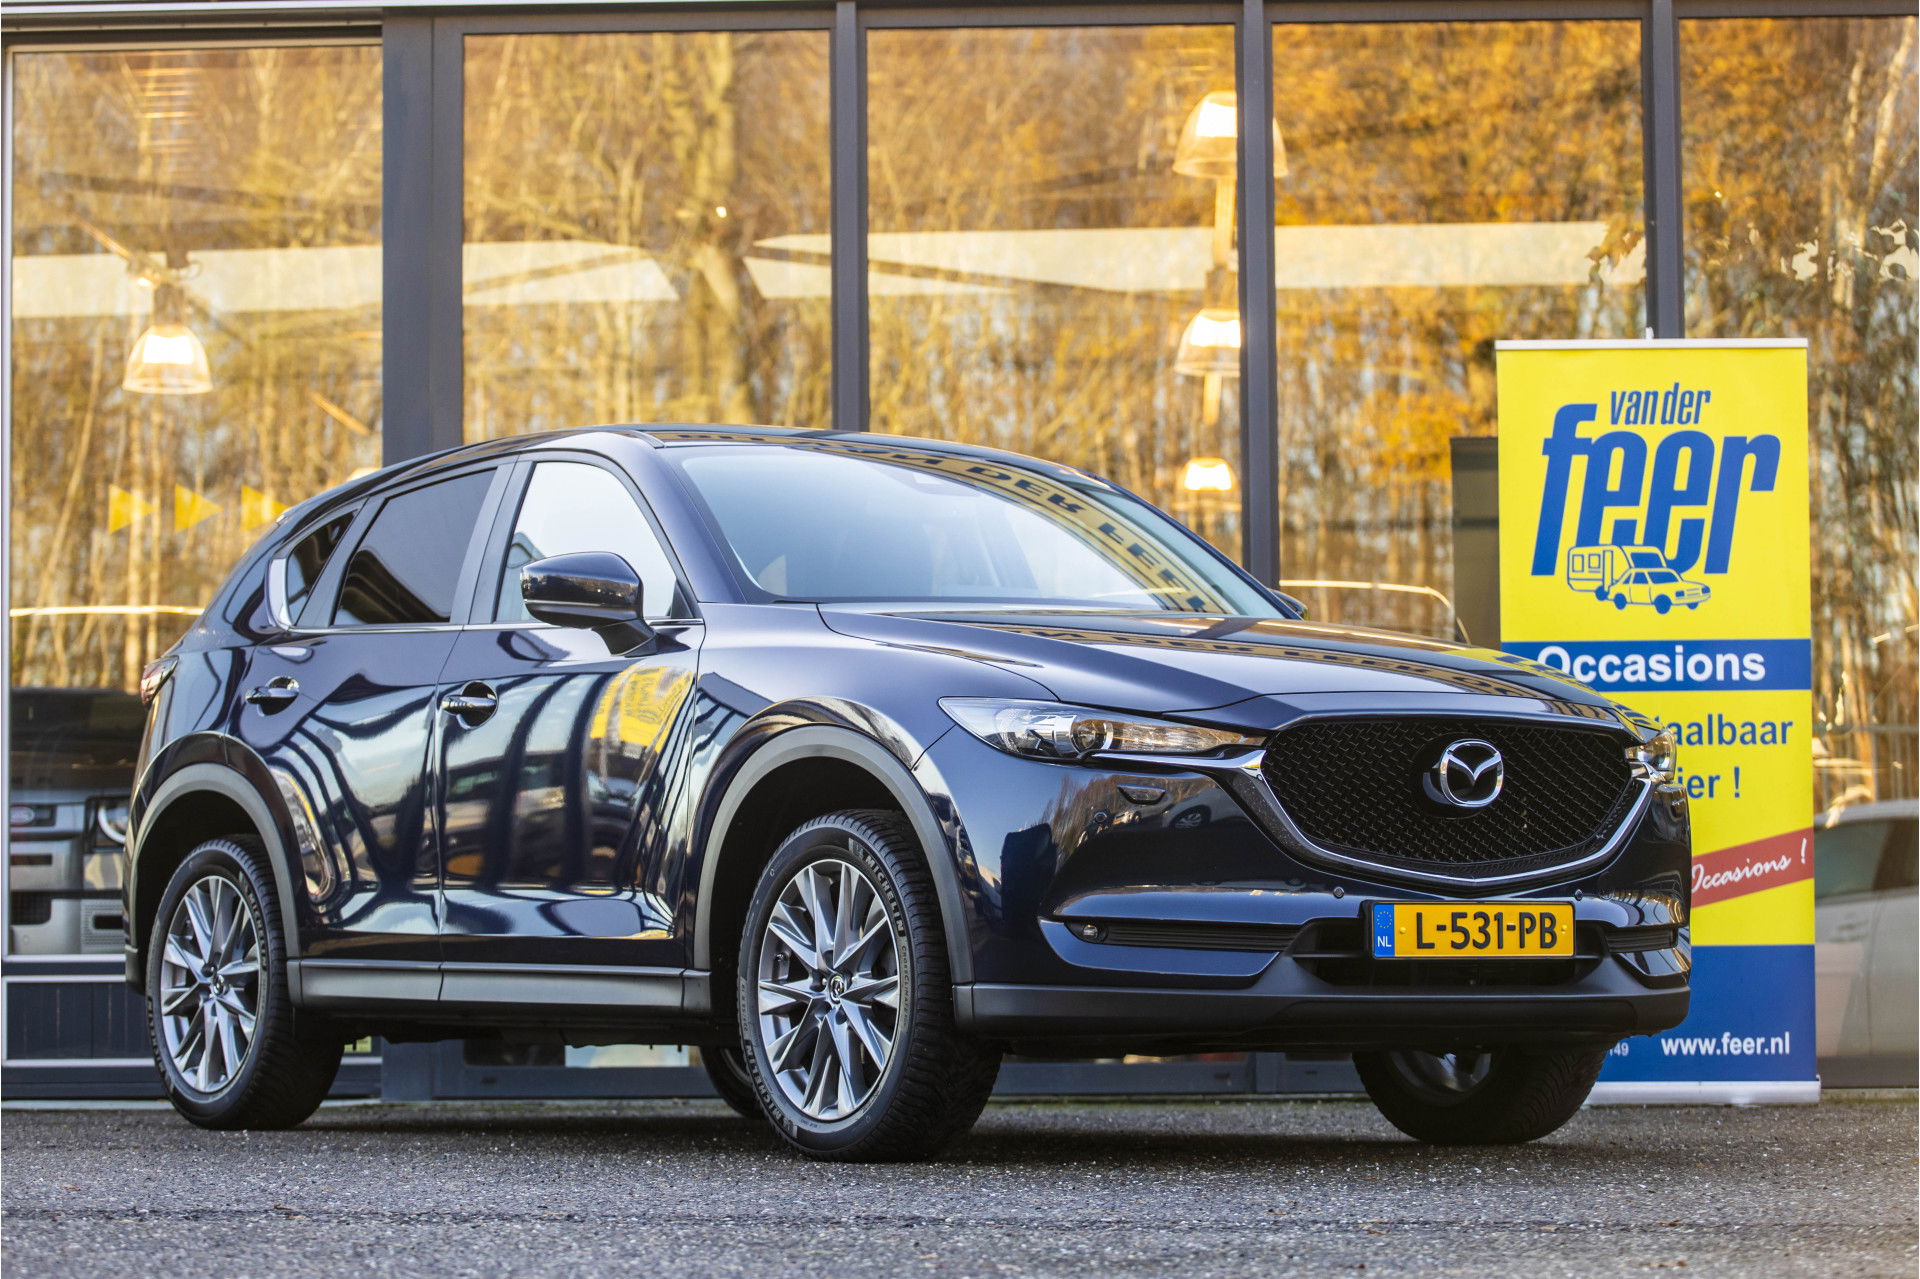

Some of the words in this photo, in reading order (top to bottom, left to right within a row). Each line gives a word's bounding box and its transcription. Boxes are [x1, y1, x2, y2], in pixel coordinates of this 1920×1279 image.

[1610, 390, 1659, 425] van
[1660, 382, 1711, 425] der
[1531, 403, 1781, 576] feer
[1537, 644, 1766, 683] Occasions
[1654, 713, 1793, 746] aalbaar
[1677, 766, 1720, 798] ier
[865, 855, 904, 931] MICHELIN
[1377, 936, 1392, 948] NL
[1416, 911, 1558, 949] L-531-PB
[1661, 1031, 1790, 1056] www.feer.nl
